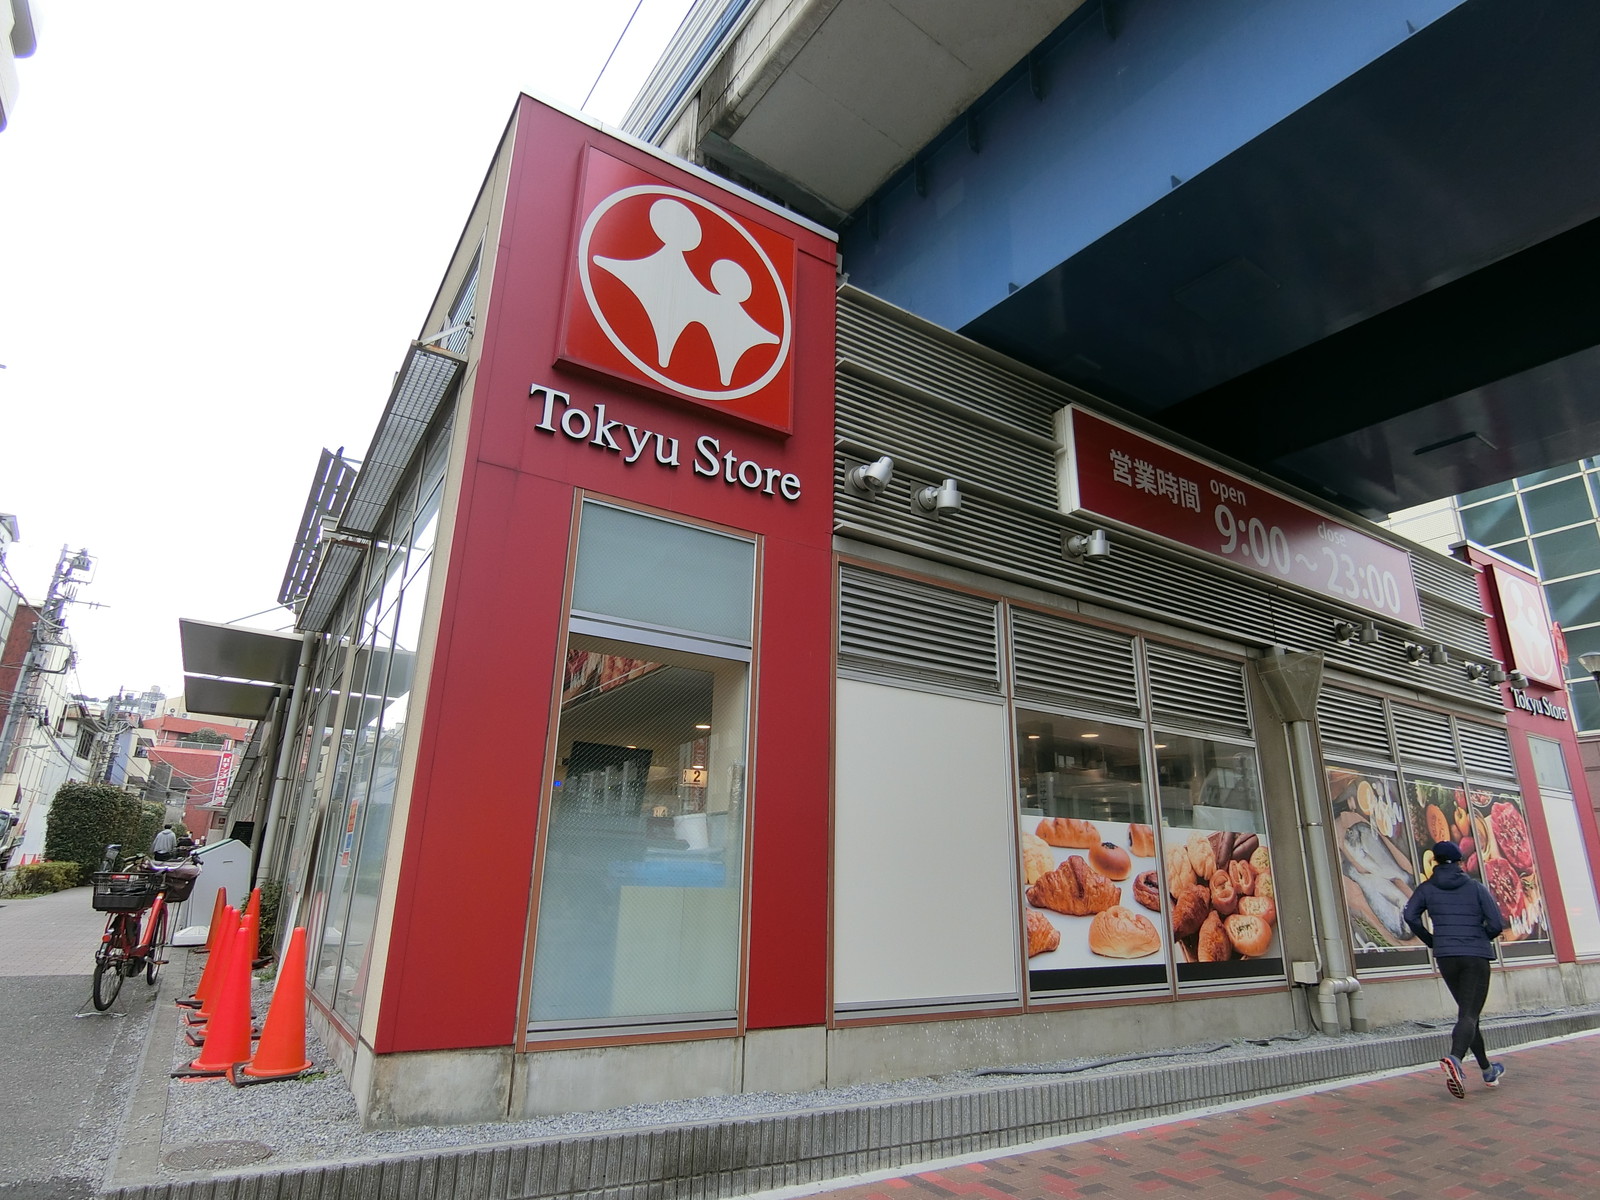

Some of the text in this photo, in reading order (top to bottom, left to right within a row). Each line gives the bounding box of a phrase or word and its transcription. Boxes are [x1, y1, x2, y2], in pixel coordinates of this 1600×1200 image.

[529, 383, 801, 500] Tokyu Store
[1109, 449, 1201, 513] 営業時間
[1209, 478, 1247, 506] open
[1317, 521, 1347, 547] close
[1510, 686, 1568, 721] Tokyu Store
[693, 770, 701, 783] 2
